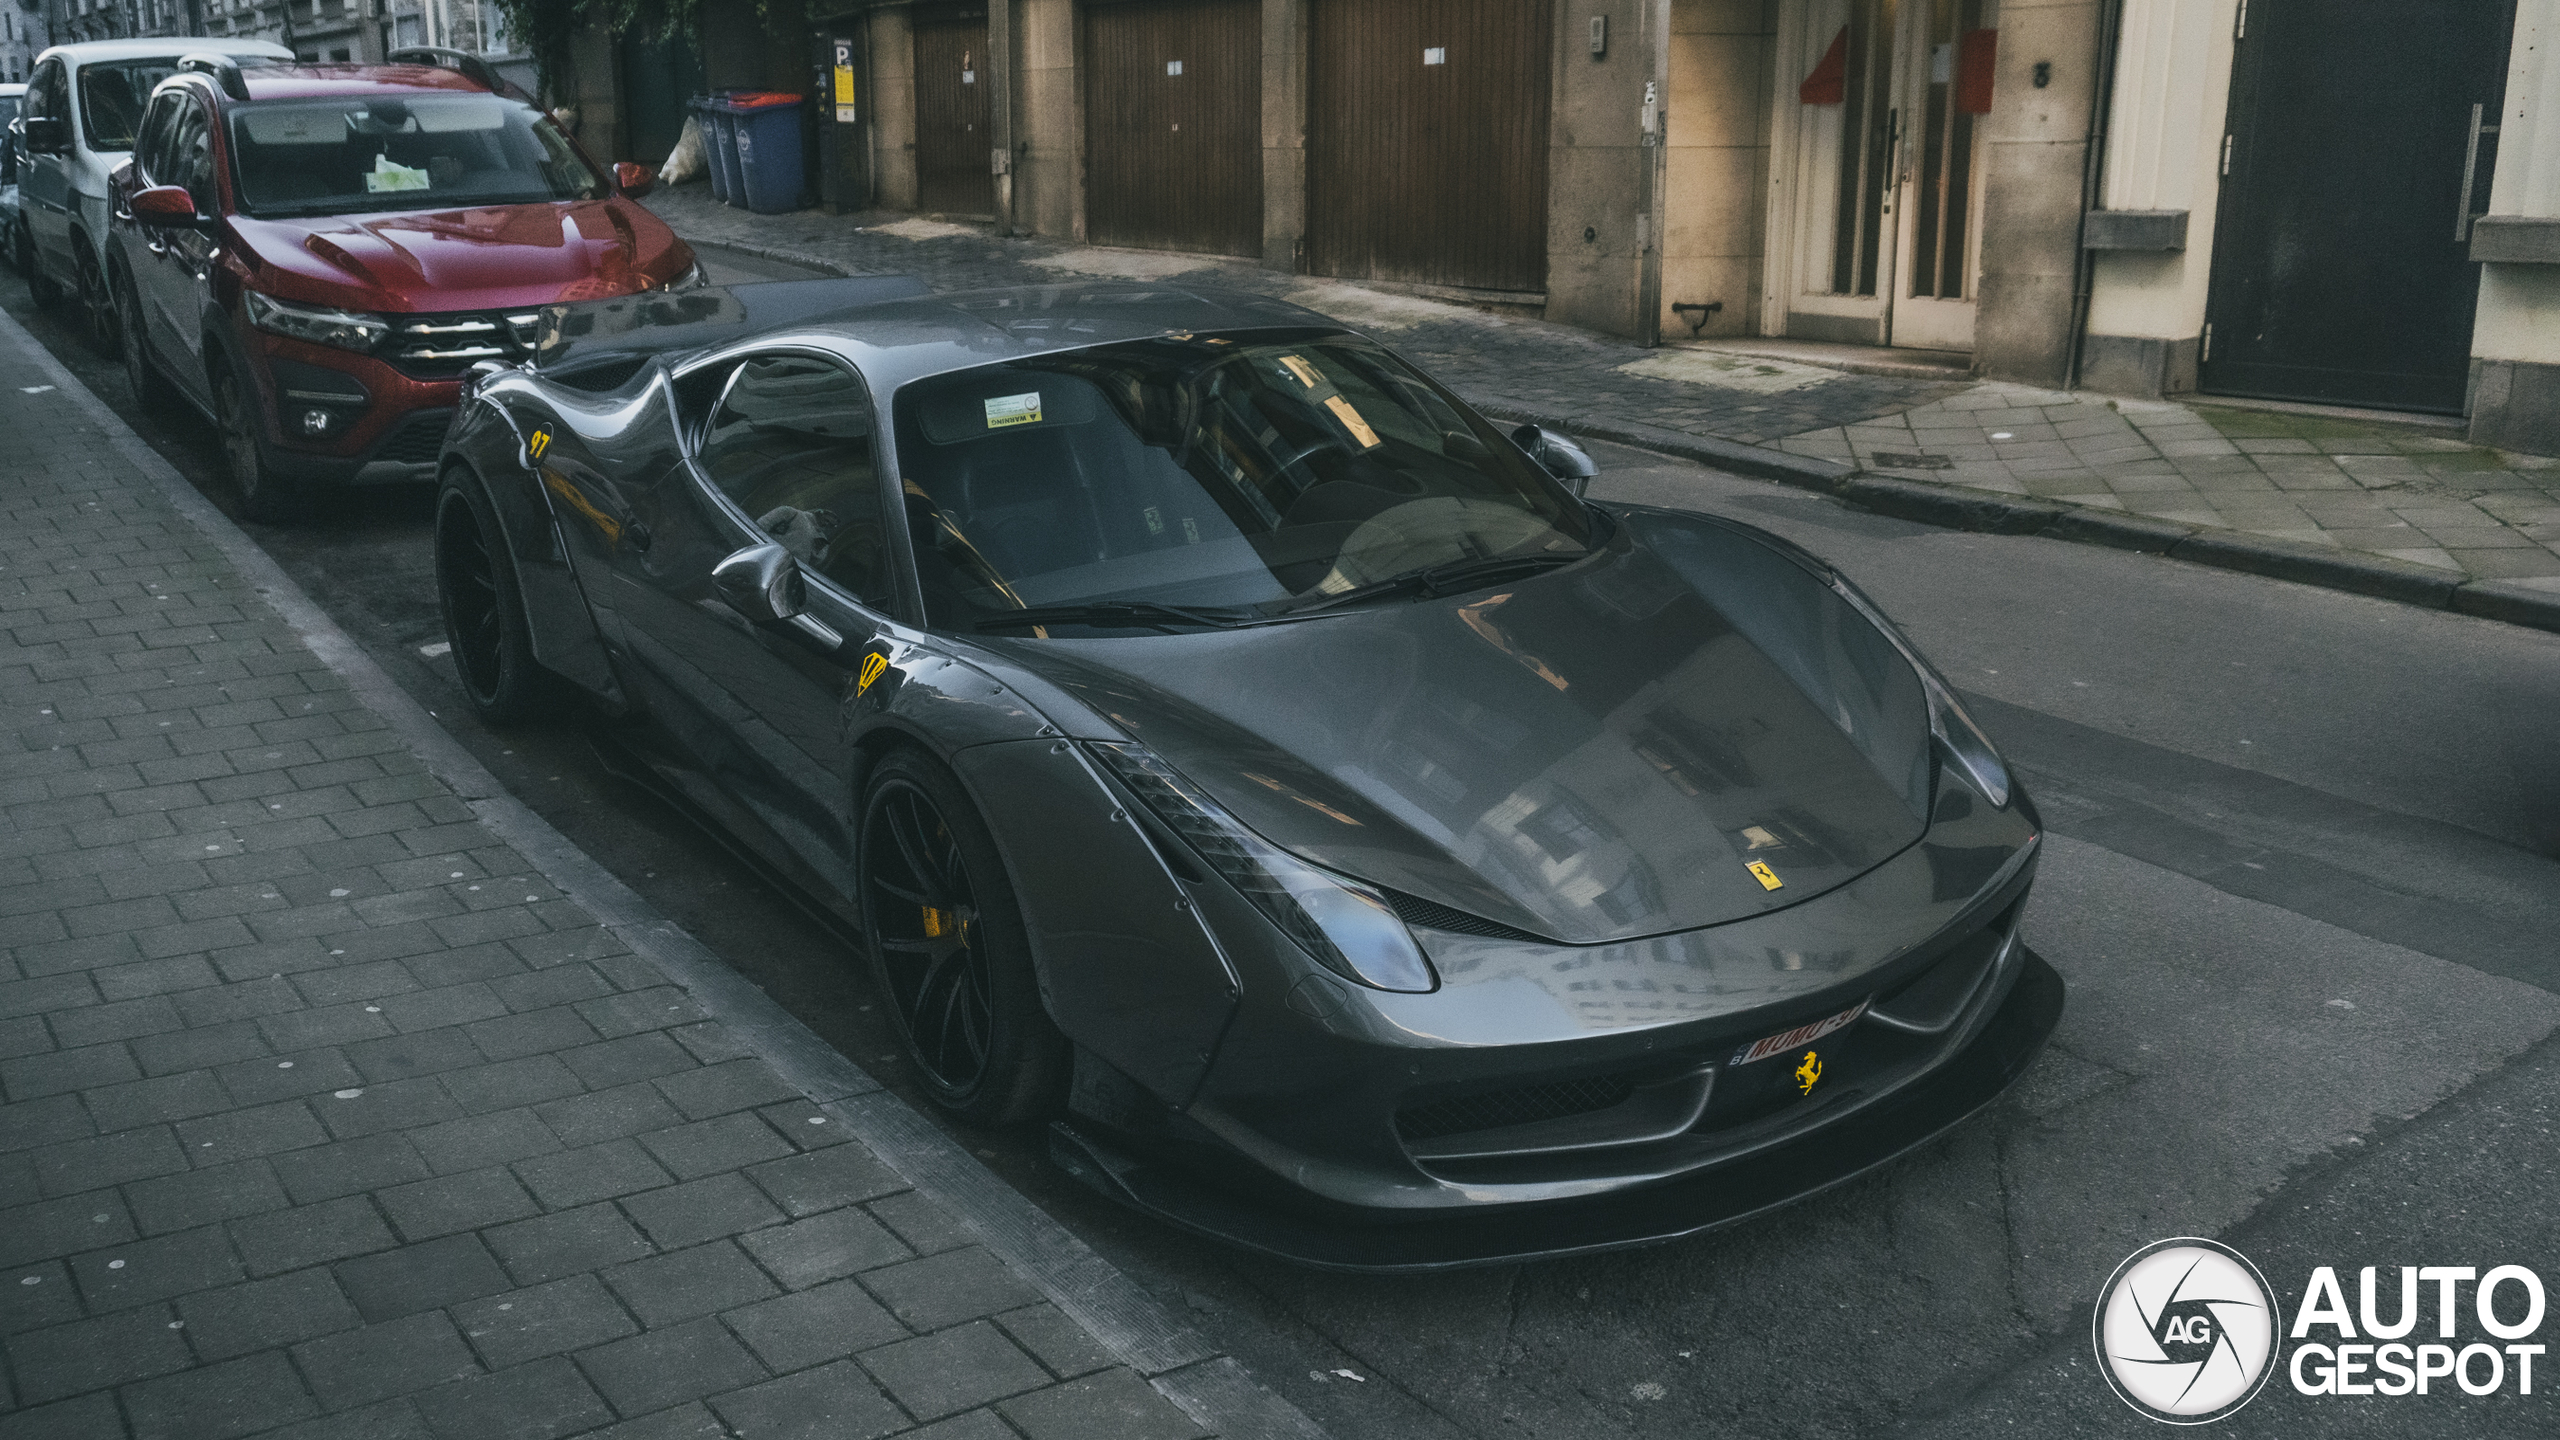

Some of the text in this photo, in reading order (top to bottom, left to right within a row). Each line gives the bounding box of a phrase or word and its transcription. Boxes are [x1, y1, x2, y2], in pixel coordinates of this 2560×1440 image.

[836, 46, 849, 65] P
[991, 415, 1027, 425] WARNING
[529, 430, 550, 458] 97
[1729, 1055, 1743, 1066] B
